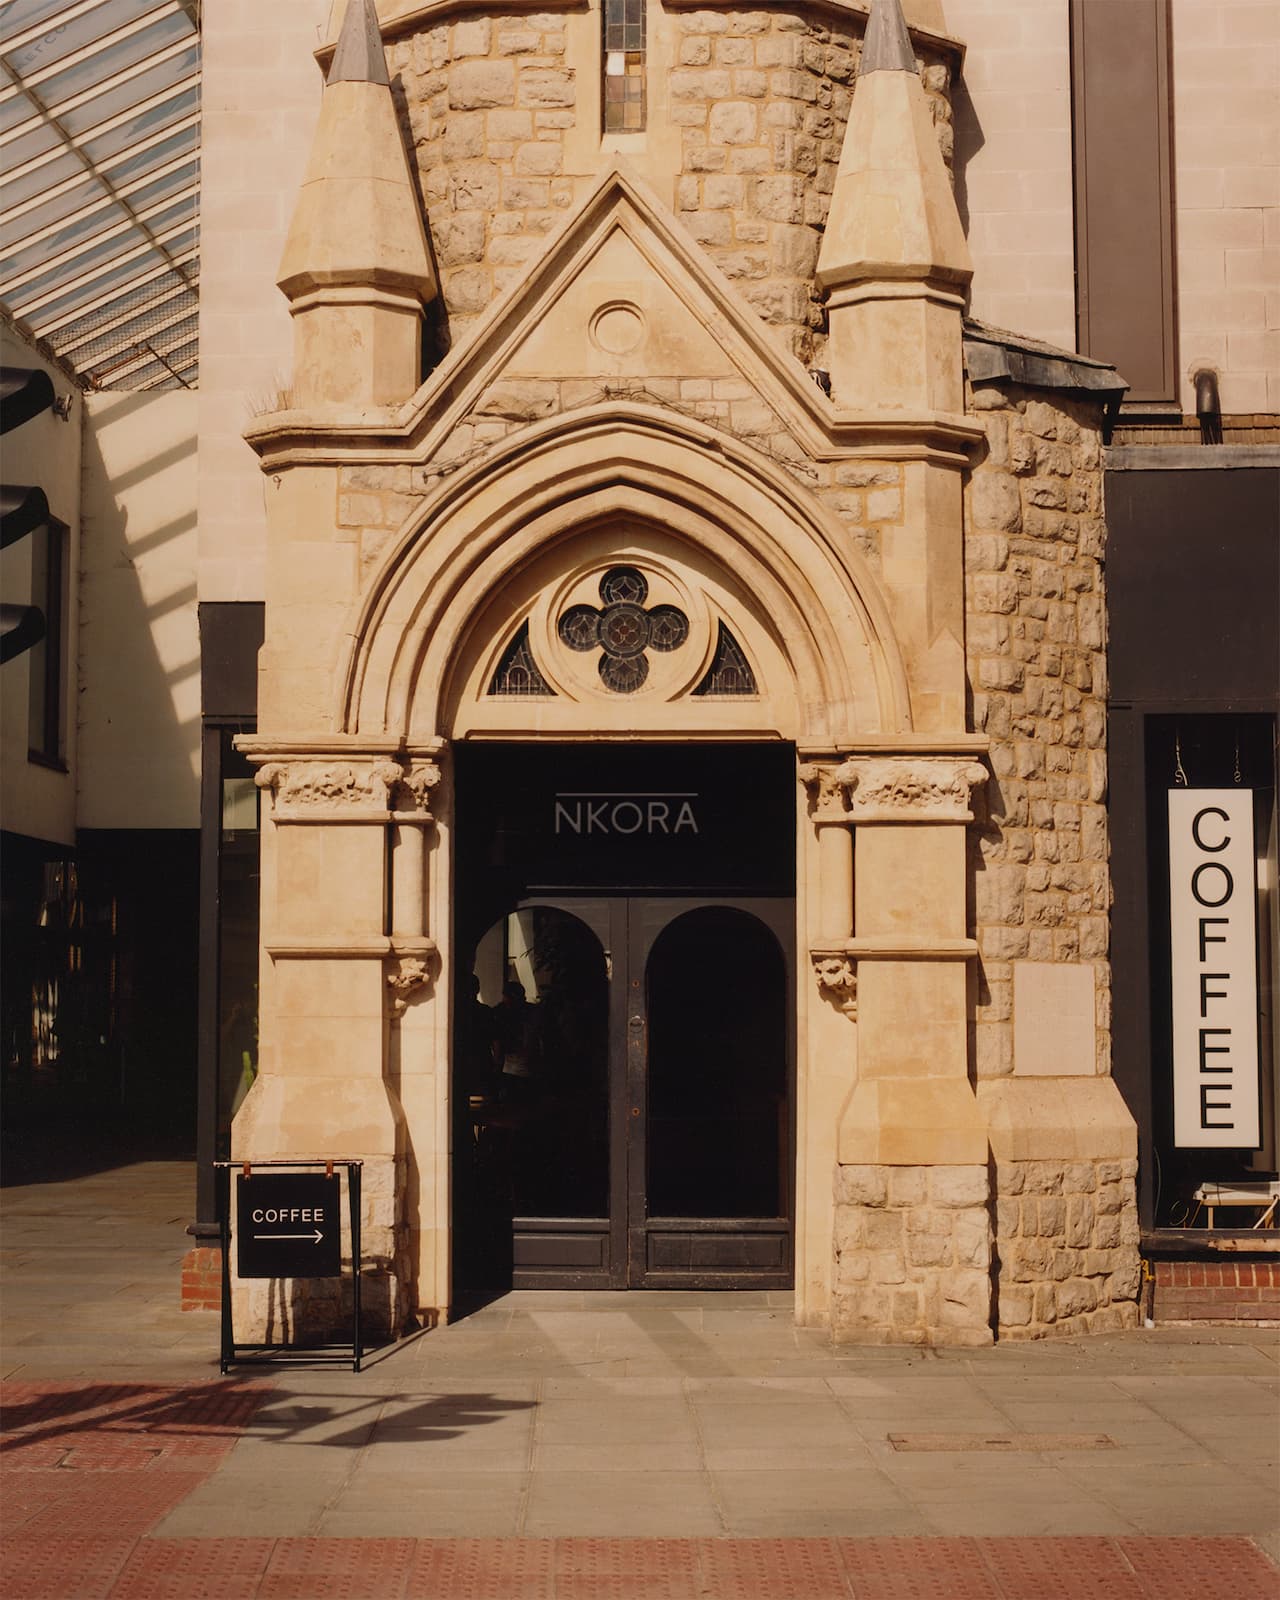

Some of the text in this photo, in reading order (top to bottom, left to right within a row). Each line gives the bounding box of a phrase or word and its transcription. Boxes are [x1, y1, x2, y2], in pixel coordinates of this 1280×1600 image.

[555, 801, 699, 834] NKORA
[1190, 806, 1235, 1130] COFFEE
[251, 1208, 325, 1223] COFFEE
